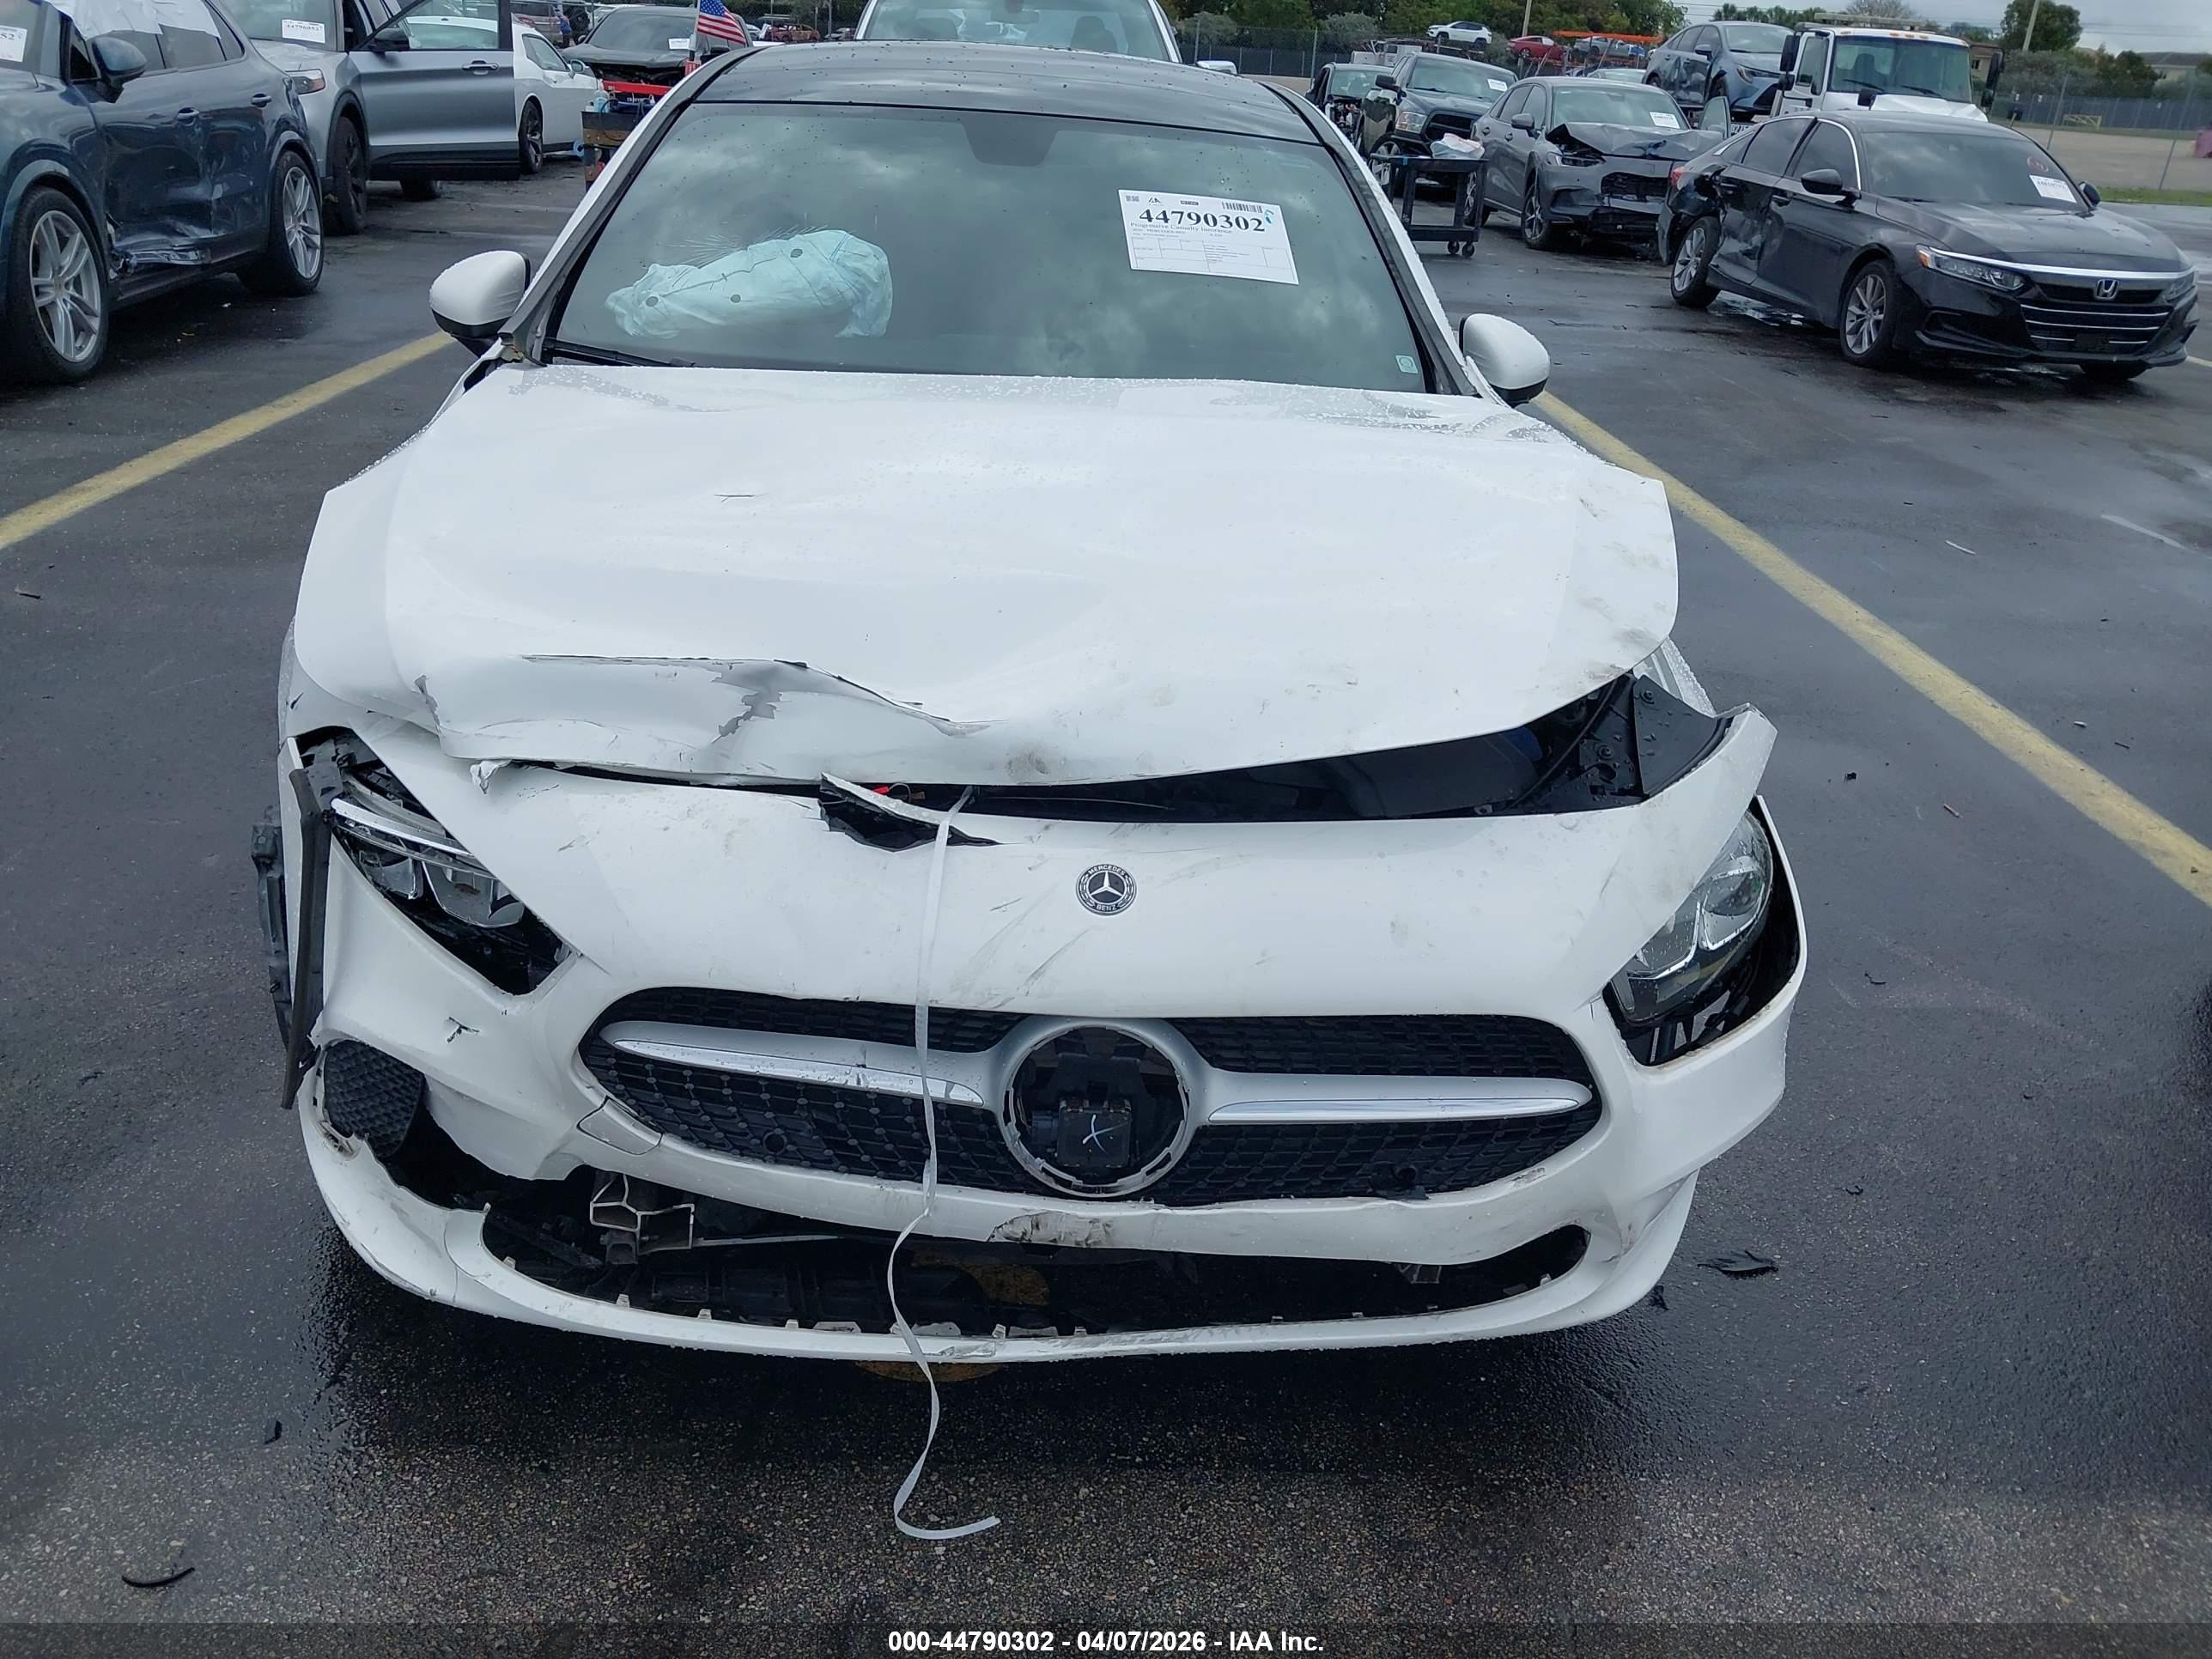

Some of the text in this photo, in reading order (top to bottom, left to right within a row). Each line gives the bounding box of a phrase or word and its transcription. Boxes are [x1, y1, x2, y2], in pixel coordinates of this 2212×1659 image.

[1139, 208, 1265, 232] 44790302
[1130, 222, 1169, 230] Progressive
[1170, 223, 1200, 233] Casualty
[1200, 226, 1232, 234] Insurance
[1087, 865, 1126, 876] MERCEDES
